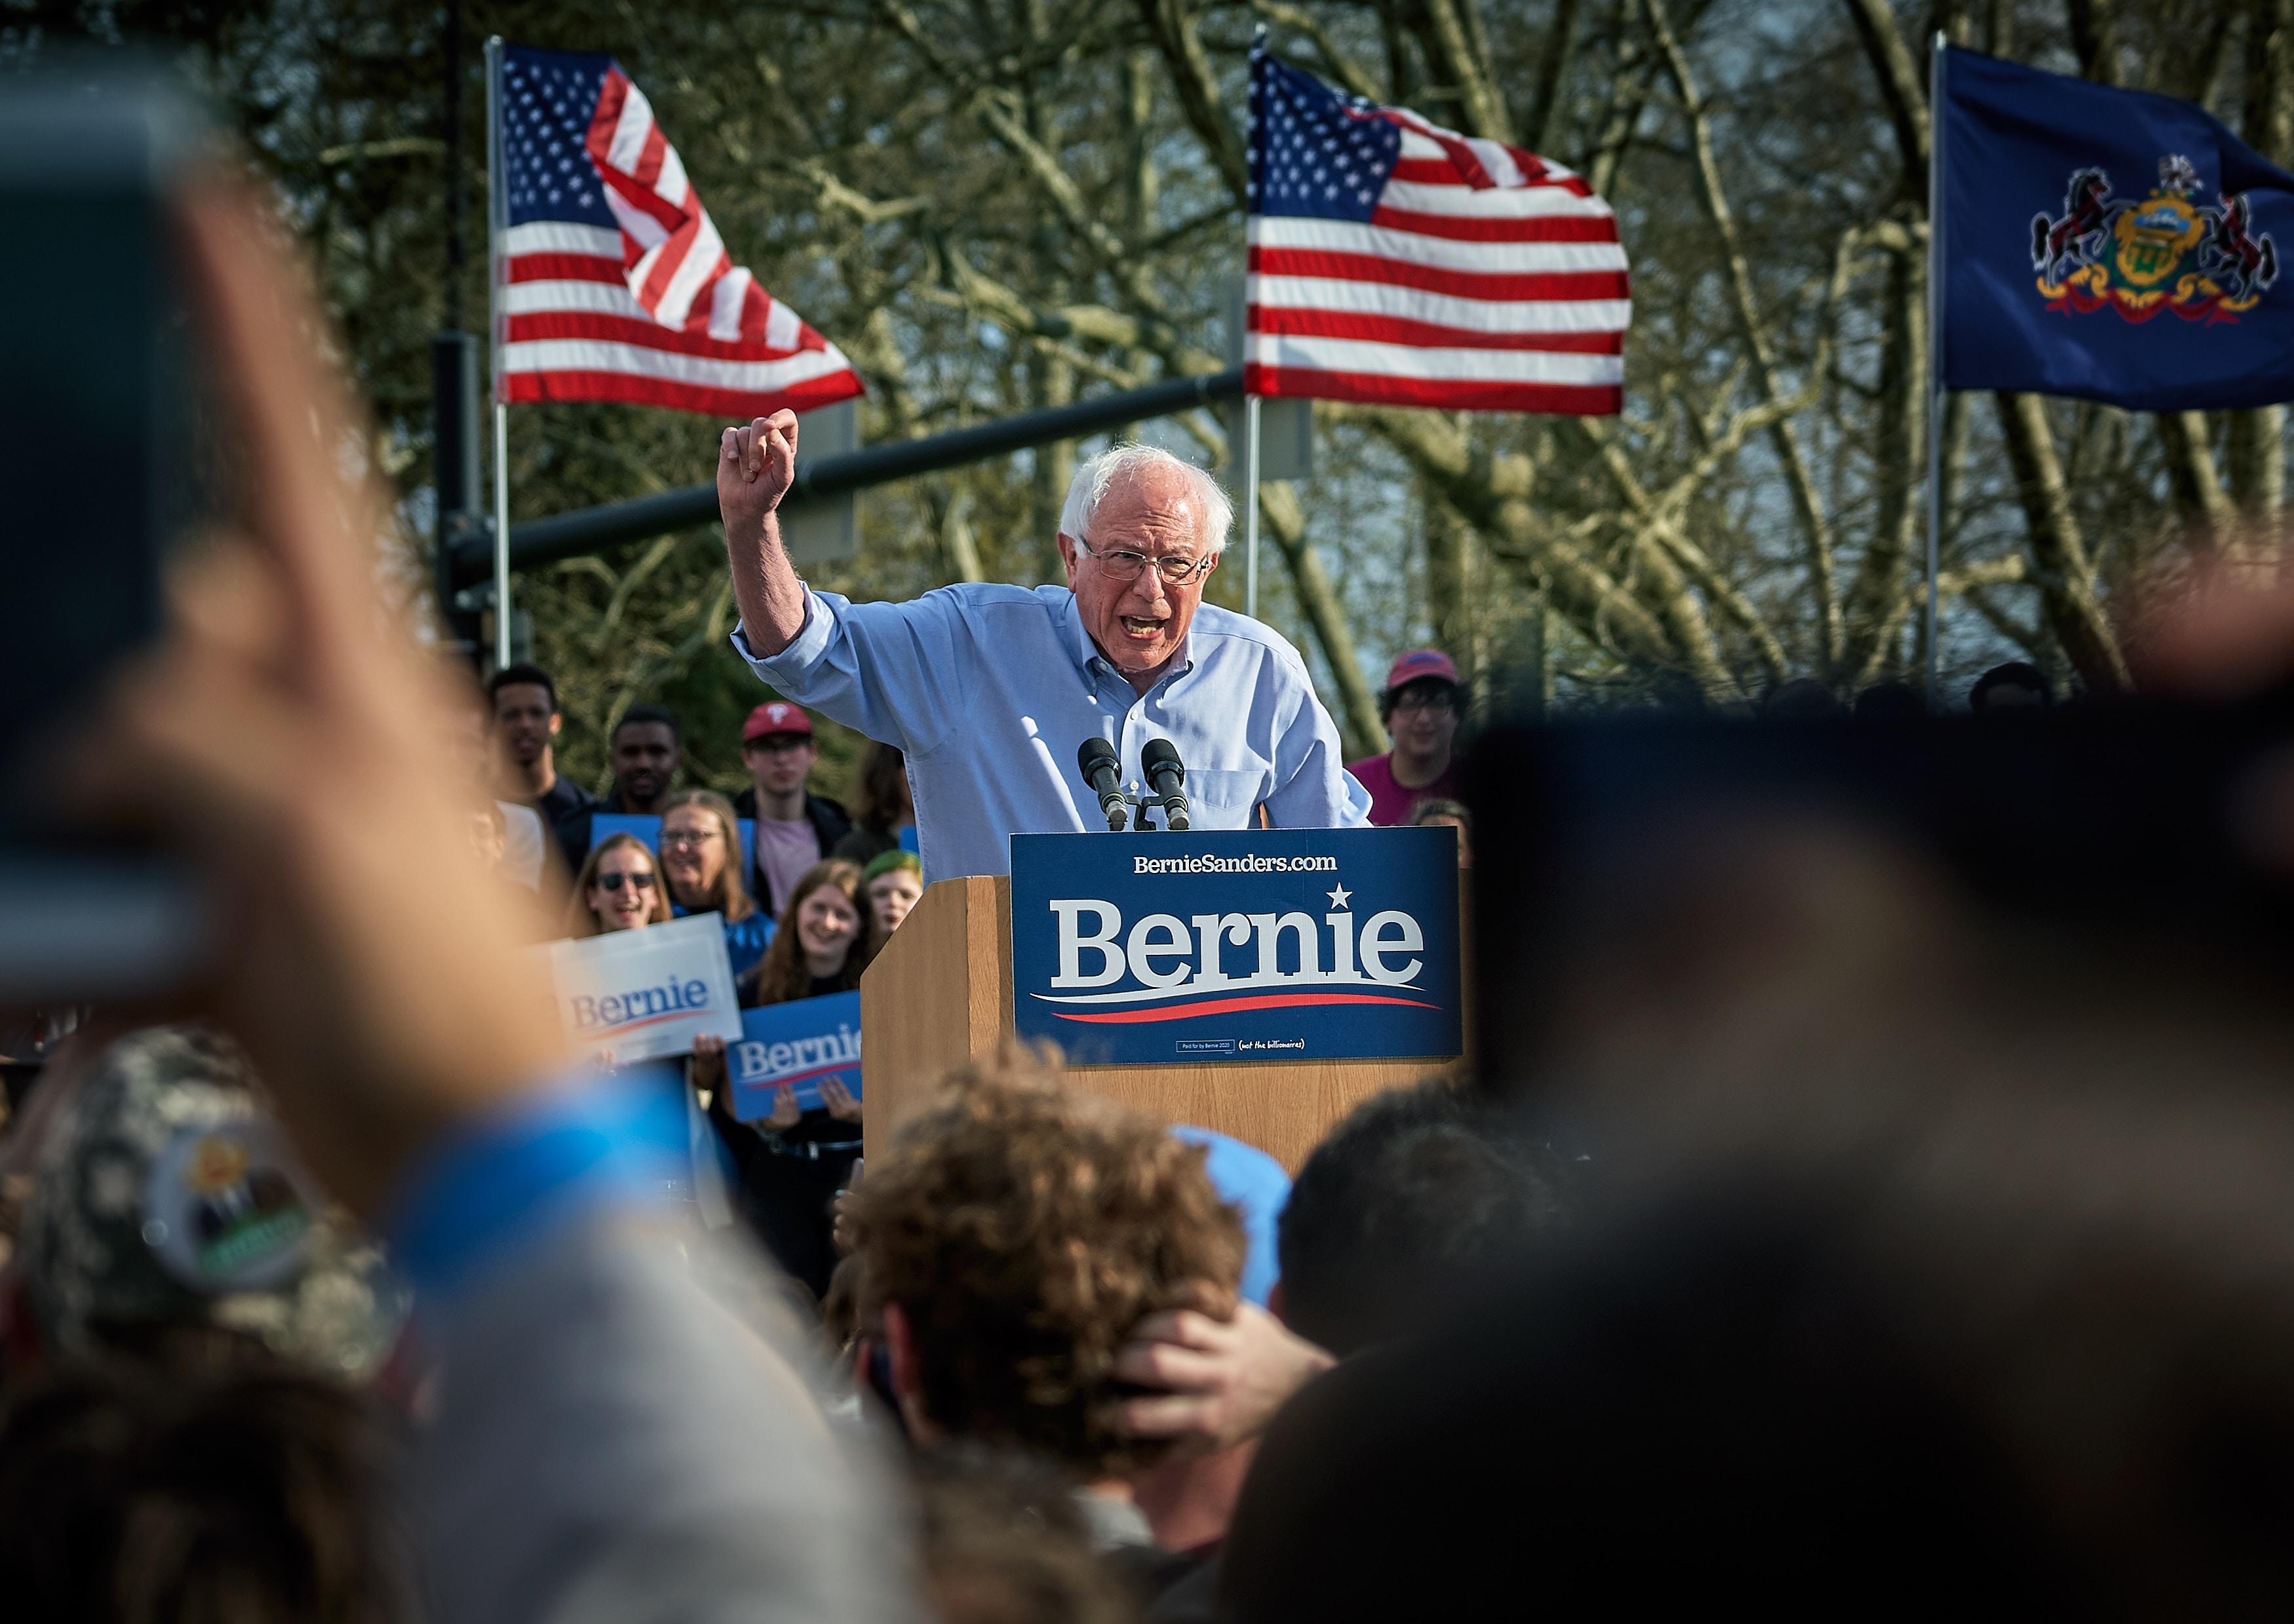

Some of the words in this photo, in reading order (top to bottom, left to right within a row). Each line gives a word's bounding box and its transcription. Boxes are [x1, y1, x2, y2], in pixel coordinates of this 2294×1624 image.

[1133, 853, 1337, 874] BernieSanders.com
[1049, 882, 1424, 988] Bernie
[572, 975, 707, 1028] Bernie
[1238, 1039, 1253, 1051] (not
[1254, 1040, 1266, 1049] the
[1267, 1037, 1305, 1050] billionaires)
